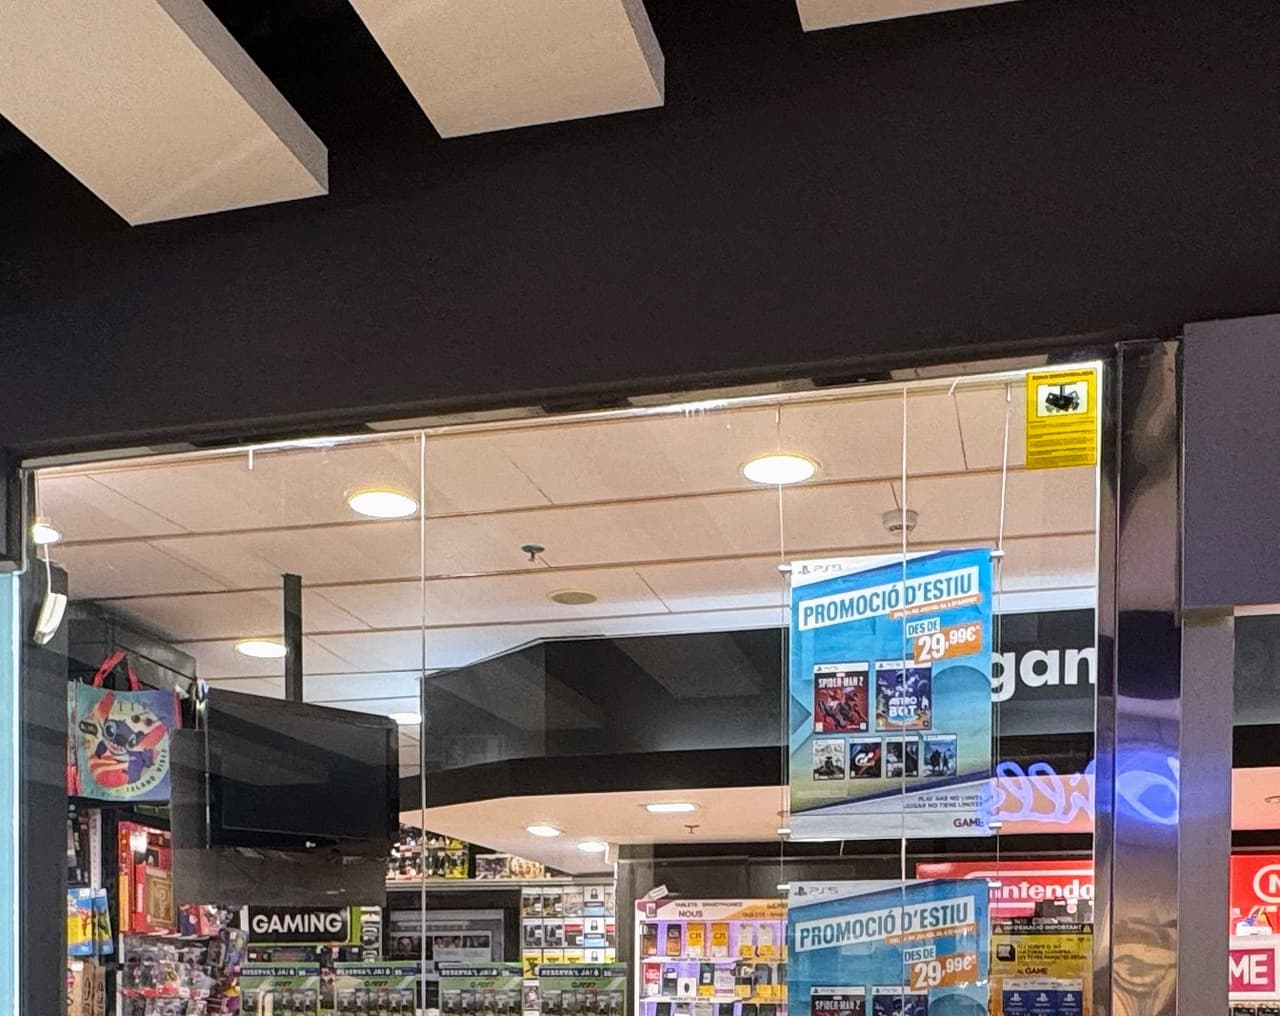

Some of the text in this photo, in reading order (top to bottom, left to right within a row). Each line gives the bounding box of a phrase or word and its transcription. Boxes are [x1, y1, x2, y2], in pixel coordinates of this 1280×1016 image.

[803, 585, 900, 626] PROMOCIÓ
[904, 573, 973, 606] D'ESTIU
[907, 619, 938, 636] DES DE
[952, 818, 985, 828] GAME
[988, 879, 1095, 900] intendo
[252, 912, 343, 934] GAMING
[678, 910, 703, 918] NOUS
[799, 910, 896, 949] PROMOCIÓ
[901, 902, 969, 933] D'ESTIU
[904, 947, 935, 962] DES DE
